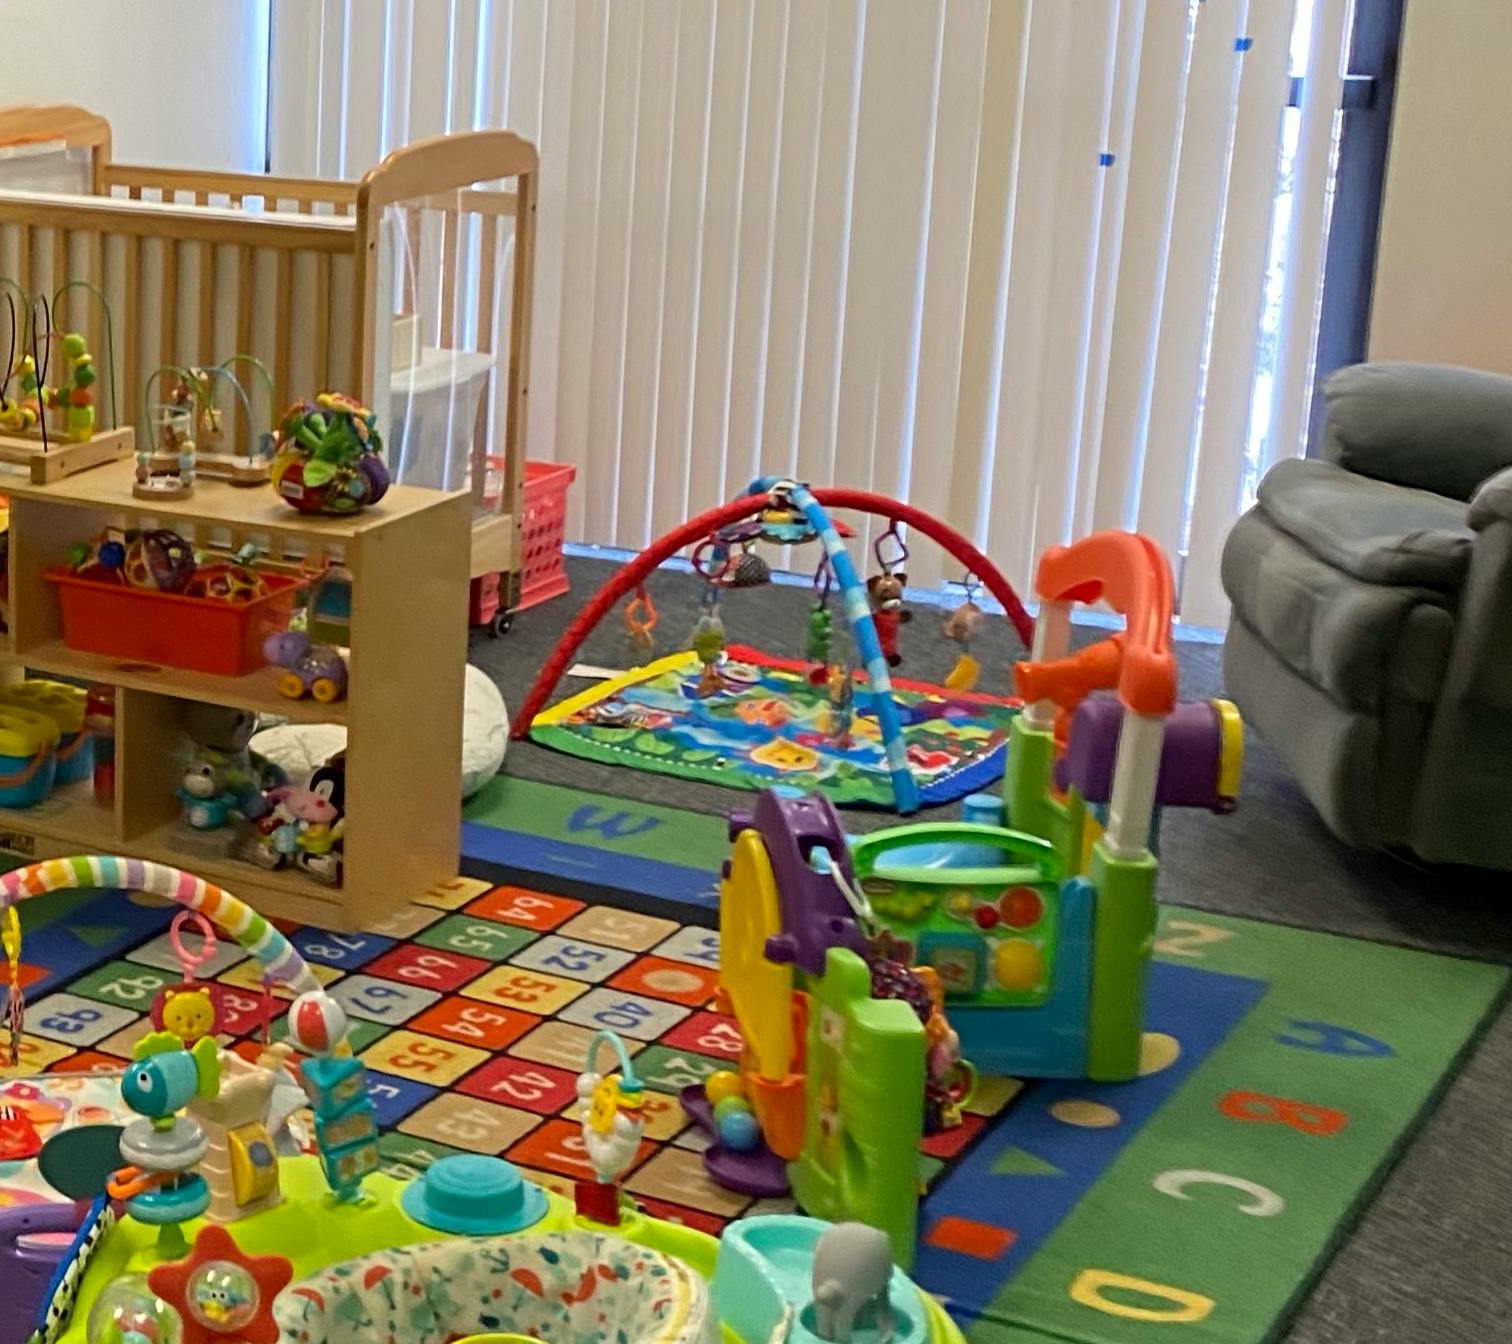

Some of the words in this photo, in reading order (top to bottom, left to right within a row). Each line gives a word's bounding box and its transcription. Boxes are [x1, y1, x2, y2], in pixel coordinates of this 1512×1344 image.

[497, 896, 555, 921] 64
[449, 925, 509, 953] 65
[397, 955, 458, 980] 66
[544, 945, 606, 972] 52
[99, 976, 164, 1000] 92
[351, 986, 408, 1015] 67
[495, 975, 557, 1003] 53
[40, 1008, 102, 1034] 93
[442, 1008, 506, 1038] 54
[593, 1001, 654, 1030] 40
[1275, 1017, 1402, 1060] A
[389, 1042, 456, 1072] 55
[490, 1071, 556, 1101] 42
[435, 1108, 502, 1141] 43
[1217, 1089, 1349, 1138] B
[1153, 1168, 1285, 1217] C
